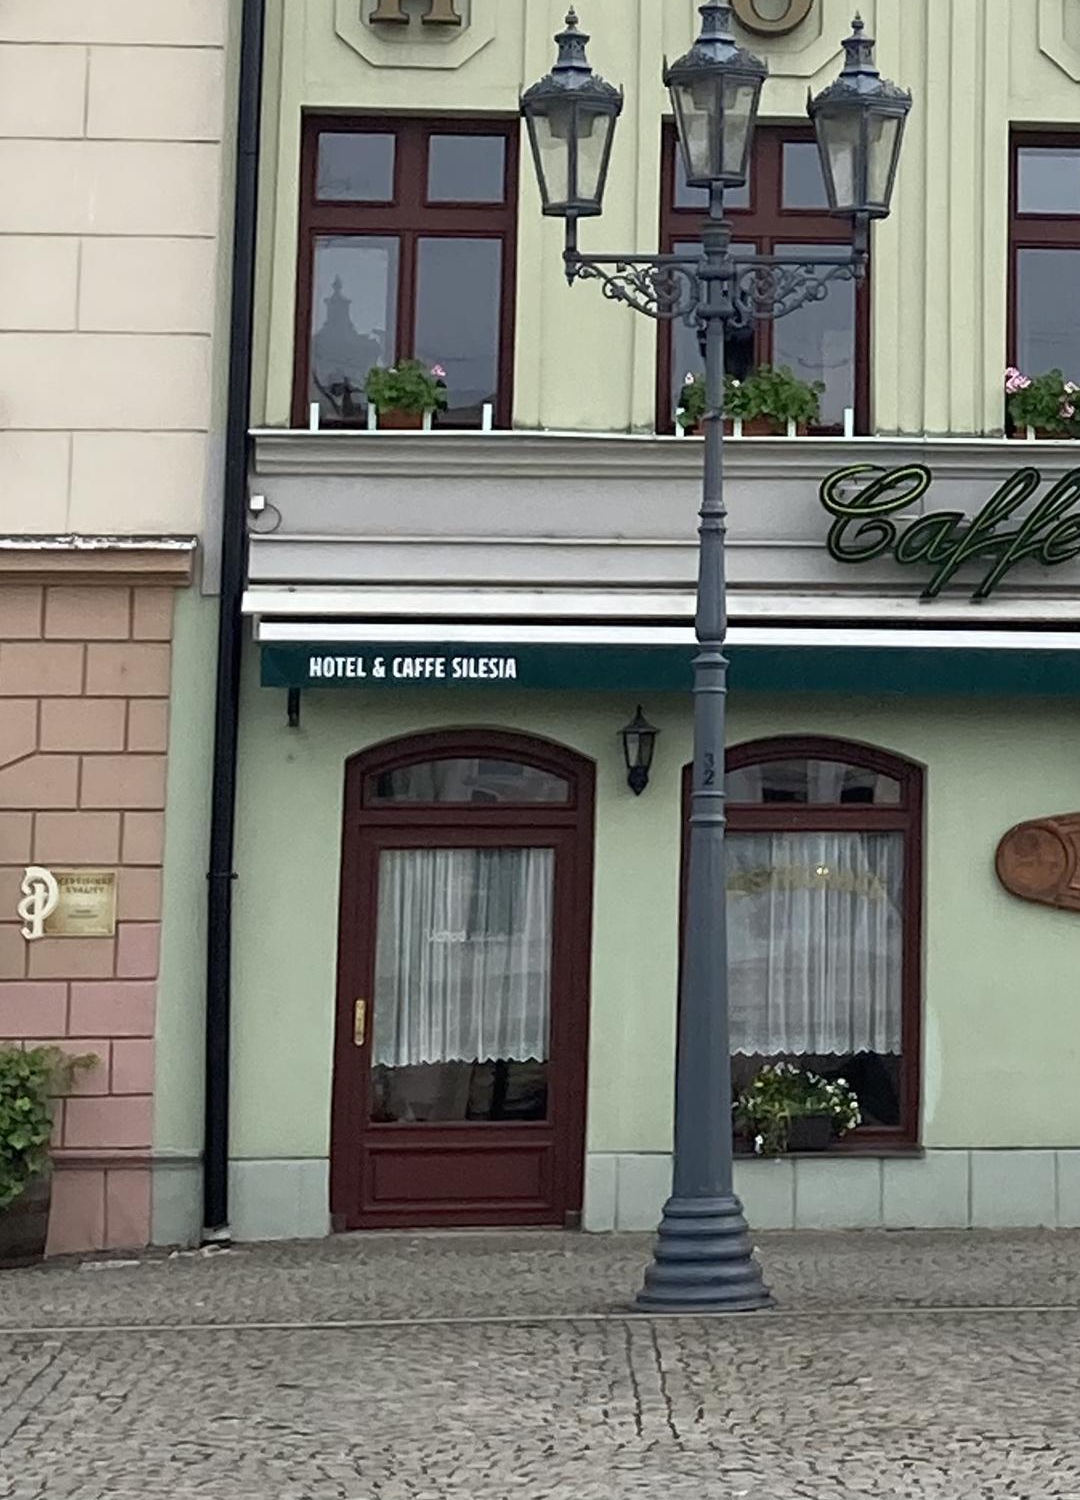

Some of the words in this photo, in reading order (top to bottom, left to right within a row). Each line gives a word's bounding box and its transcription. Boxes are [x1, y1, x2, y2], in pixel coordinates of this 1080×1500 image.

[309, 657, 367, 678] HOTEL
[372, 657, 386, 678] &
[392, 657, 446, 678] CAFFE
[452, 657, 517, 679] SILESIA
